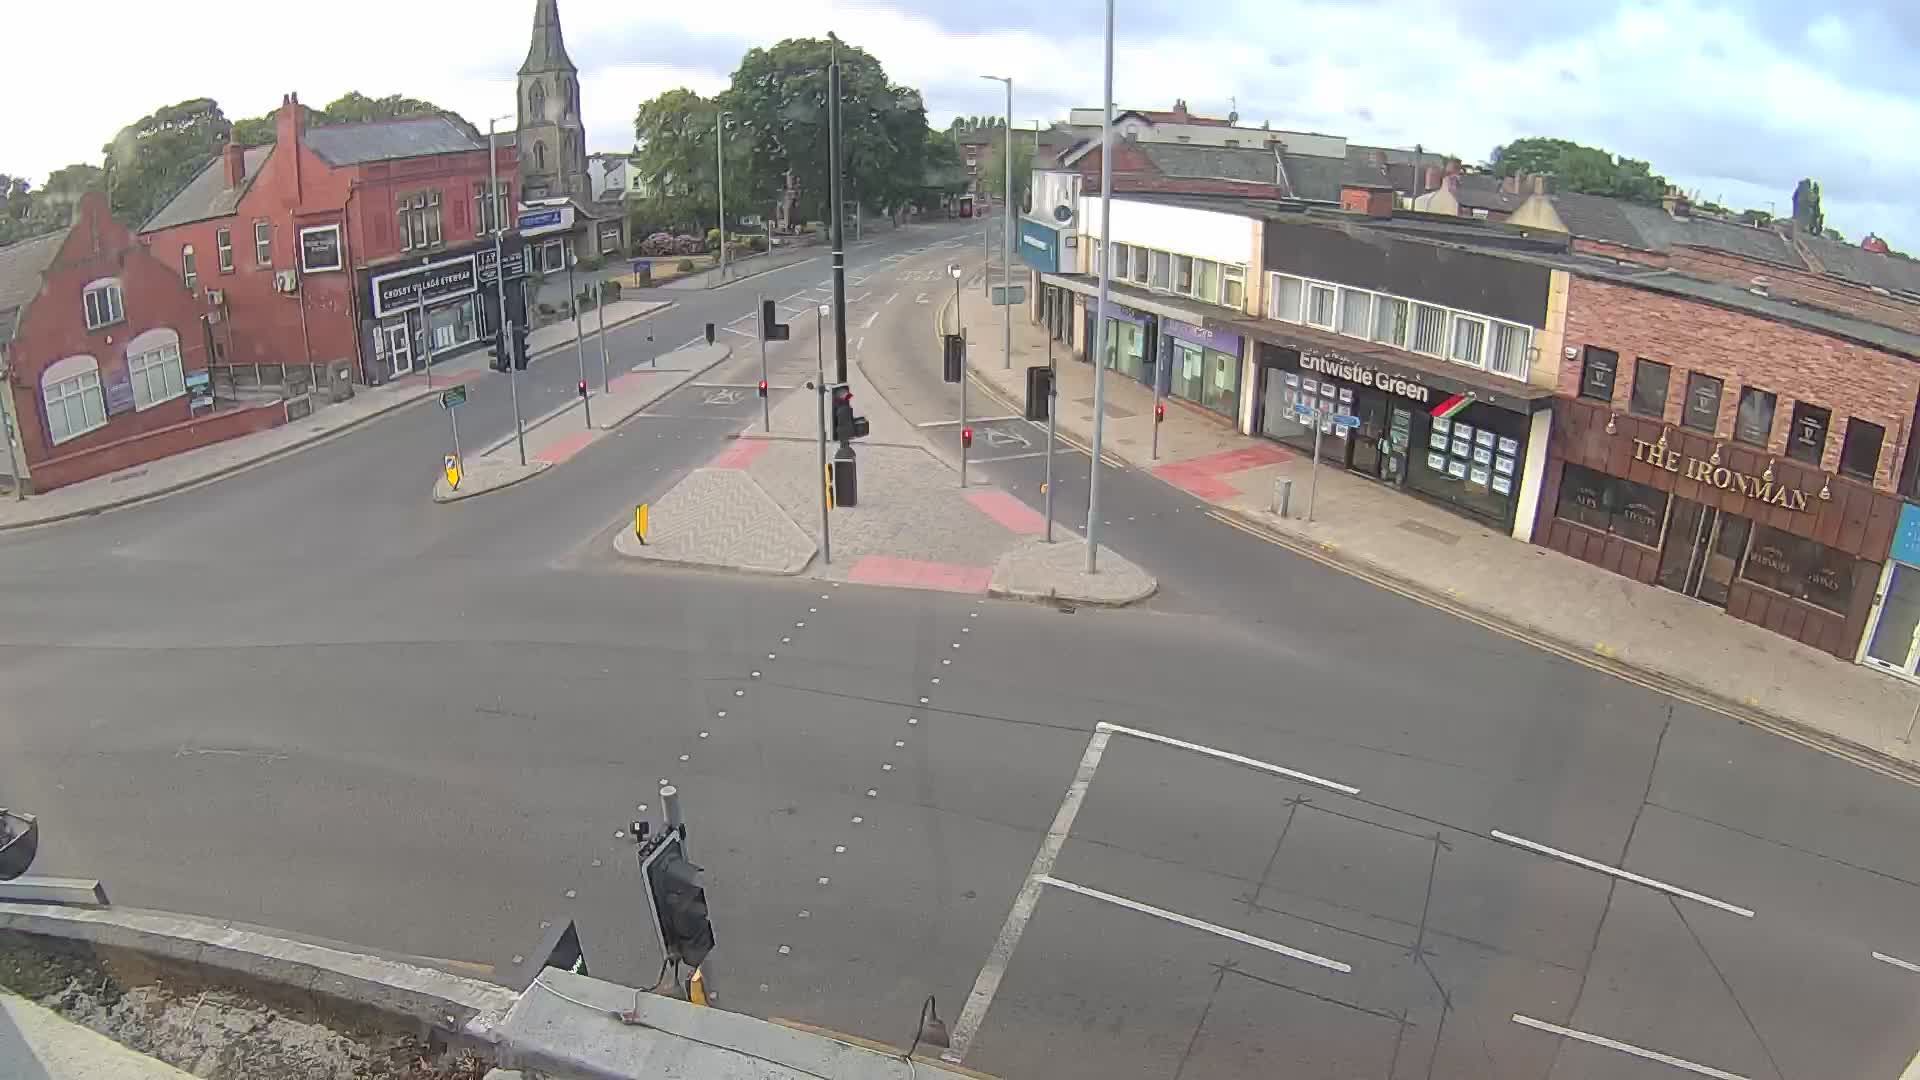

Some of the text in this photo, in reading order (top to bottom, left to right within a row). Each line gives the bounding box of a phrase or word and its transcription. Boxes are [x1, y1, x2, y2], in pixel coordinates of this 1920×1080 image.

[383, 286, 411, 300] CROSBY
[412, 277, 440, 292] VILLAGE
[440, 271, 470, 286] EYEWEAR
[1300, 351, 1429, 403] Entwistle Green
[1632, 438, 1813, 512] THE IRONMAN
